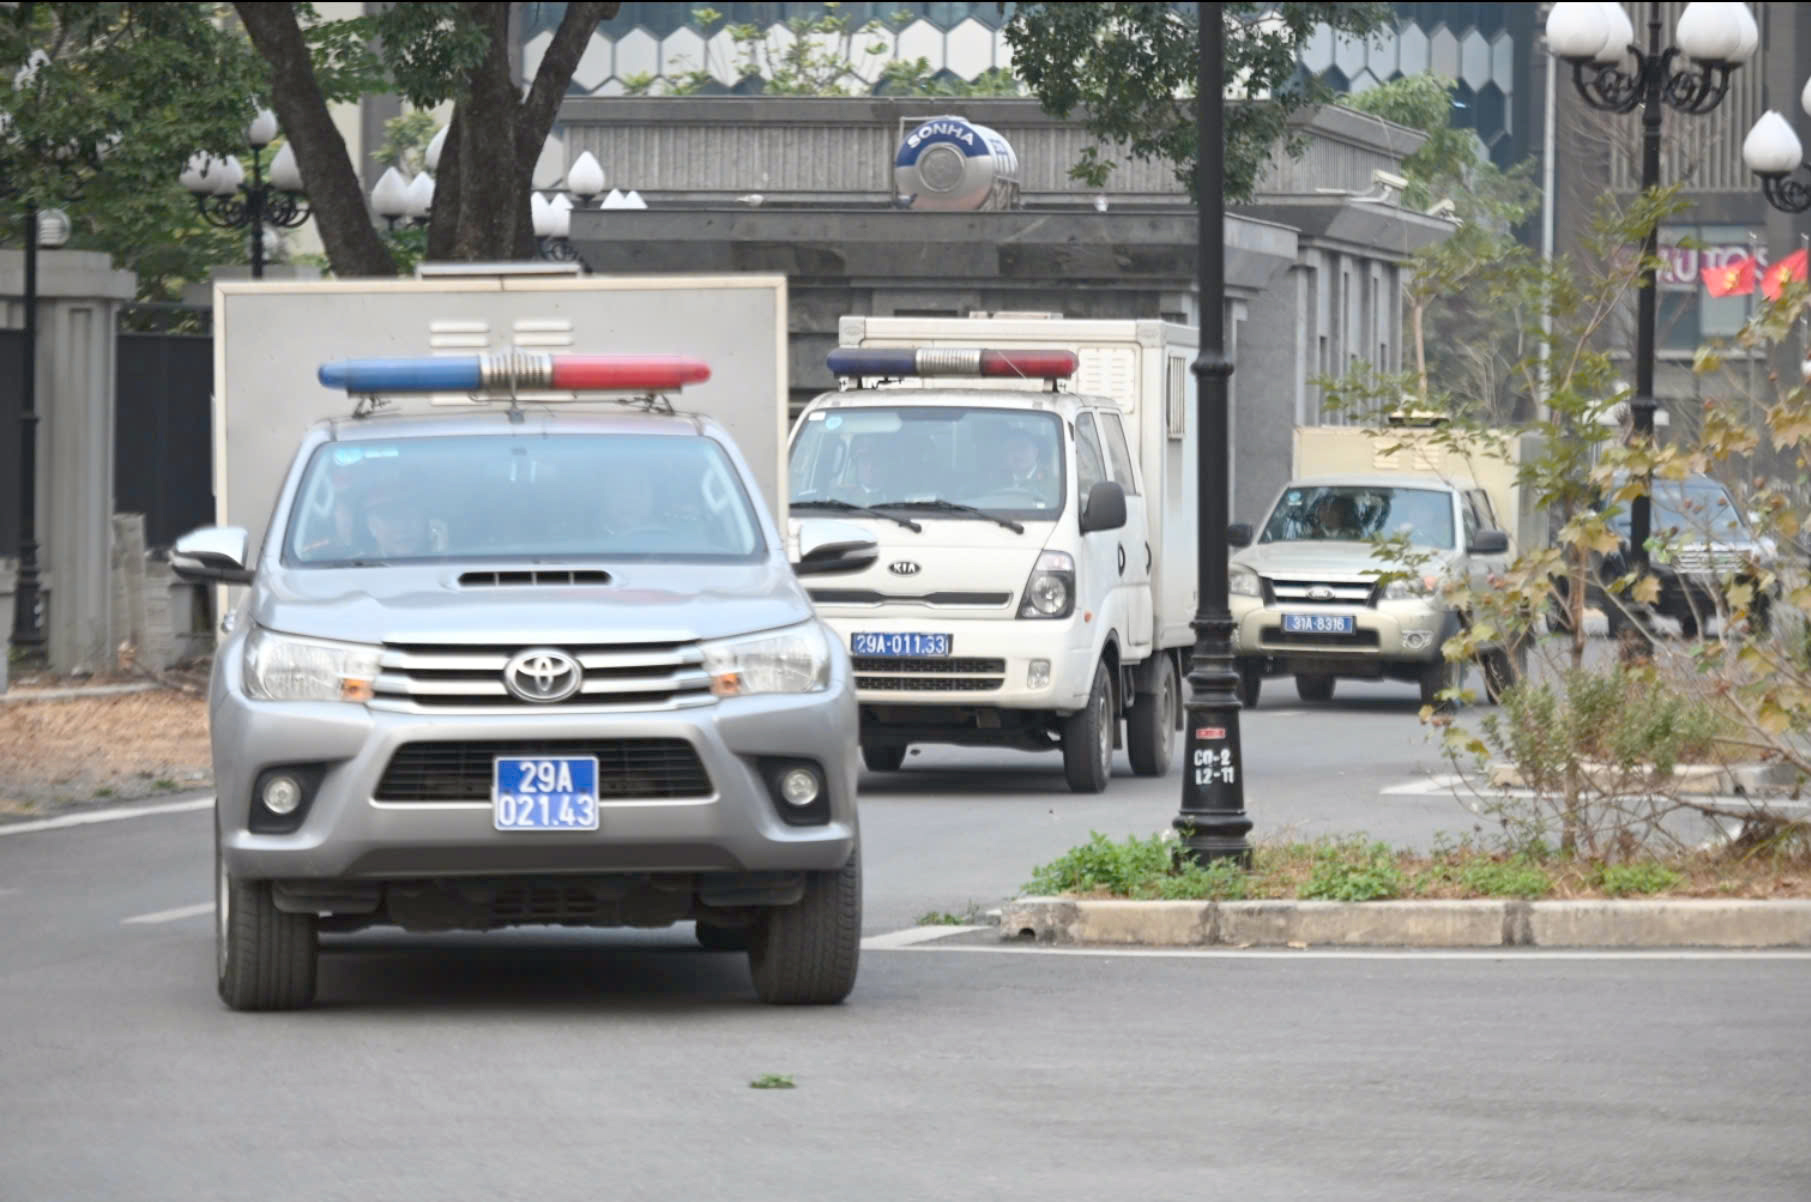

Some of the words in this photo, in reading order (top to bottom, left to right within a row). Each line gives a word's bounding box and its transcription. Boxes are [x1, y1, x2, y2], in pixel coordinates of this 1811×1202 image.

[907, 122, 975, 149] SONHA
[891, 562, 918, 574] KIA
[856, 634, 946, 655] 29A-011.33
[519, 761, 574, 793] 29A
[499, 794, 595, 827] 021.43
